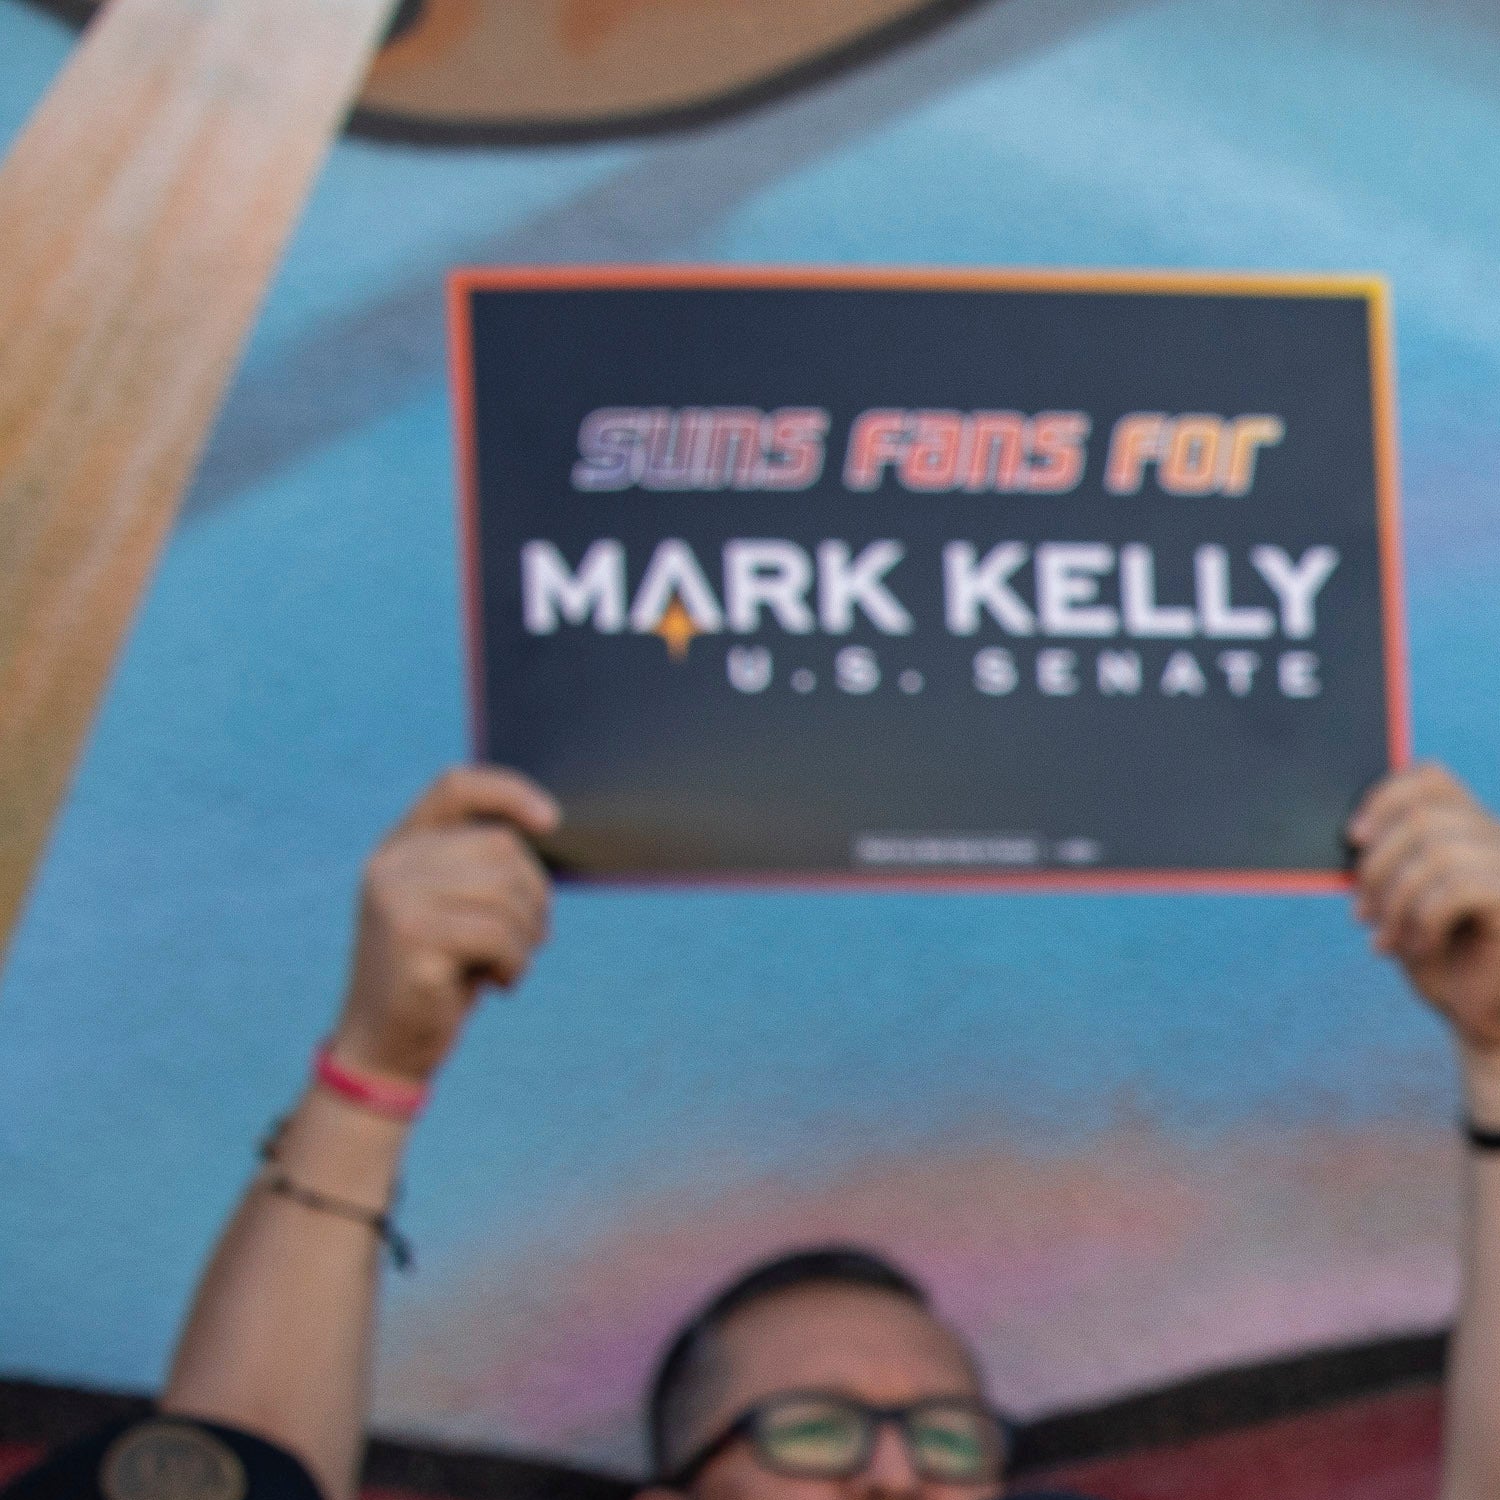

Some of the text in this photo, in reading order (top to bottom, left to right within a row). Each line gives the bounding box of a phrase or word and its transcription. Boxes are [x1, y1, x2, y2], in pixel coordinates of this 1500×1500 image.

[520, 539, 1340, 640] MARK KELLY
[726, 647, 1323, 697] U.S. SENATE
